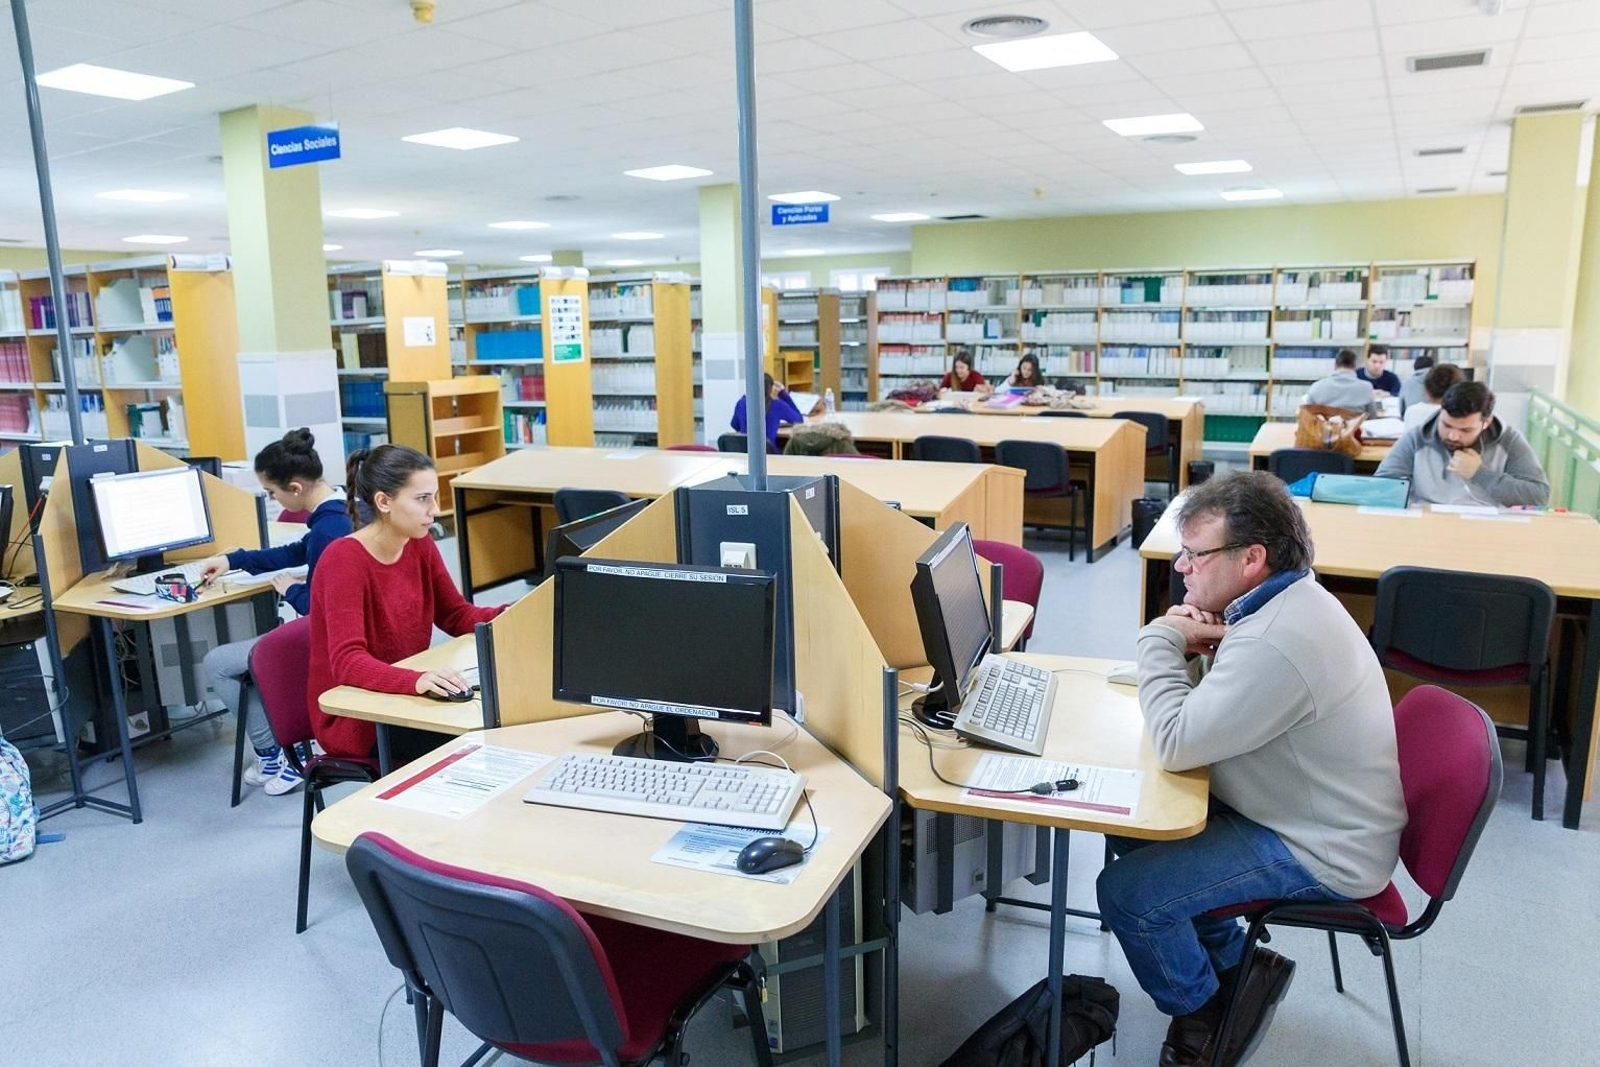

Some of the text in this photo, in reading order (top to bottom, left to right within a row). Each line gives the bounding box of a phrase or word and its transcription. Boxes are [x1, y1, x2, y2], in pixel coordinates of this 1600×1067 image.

[271, 136, 337, 155] Ciencias Sociales
[728, 506, 746, 514] ISL 5
[664, 572, 688, 580] CIERRE
[640, 703, 665, 711] APAGUE
[674, 706, 716, 717] ORDENADOR
